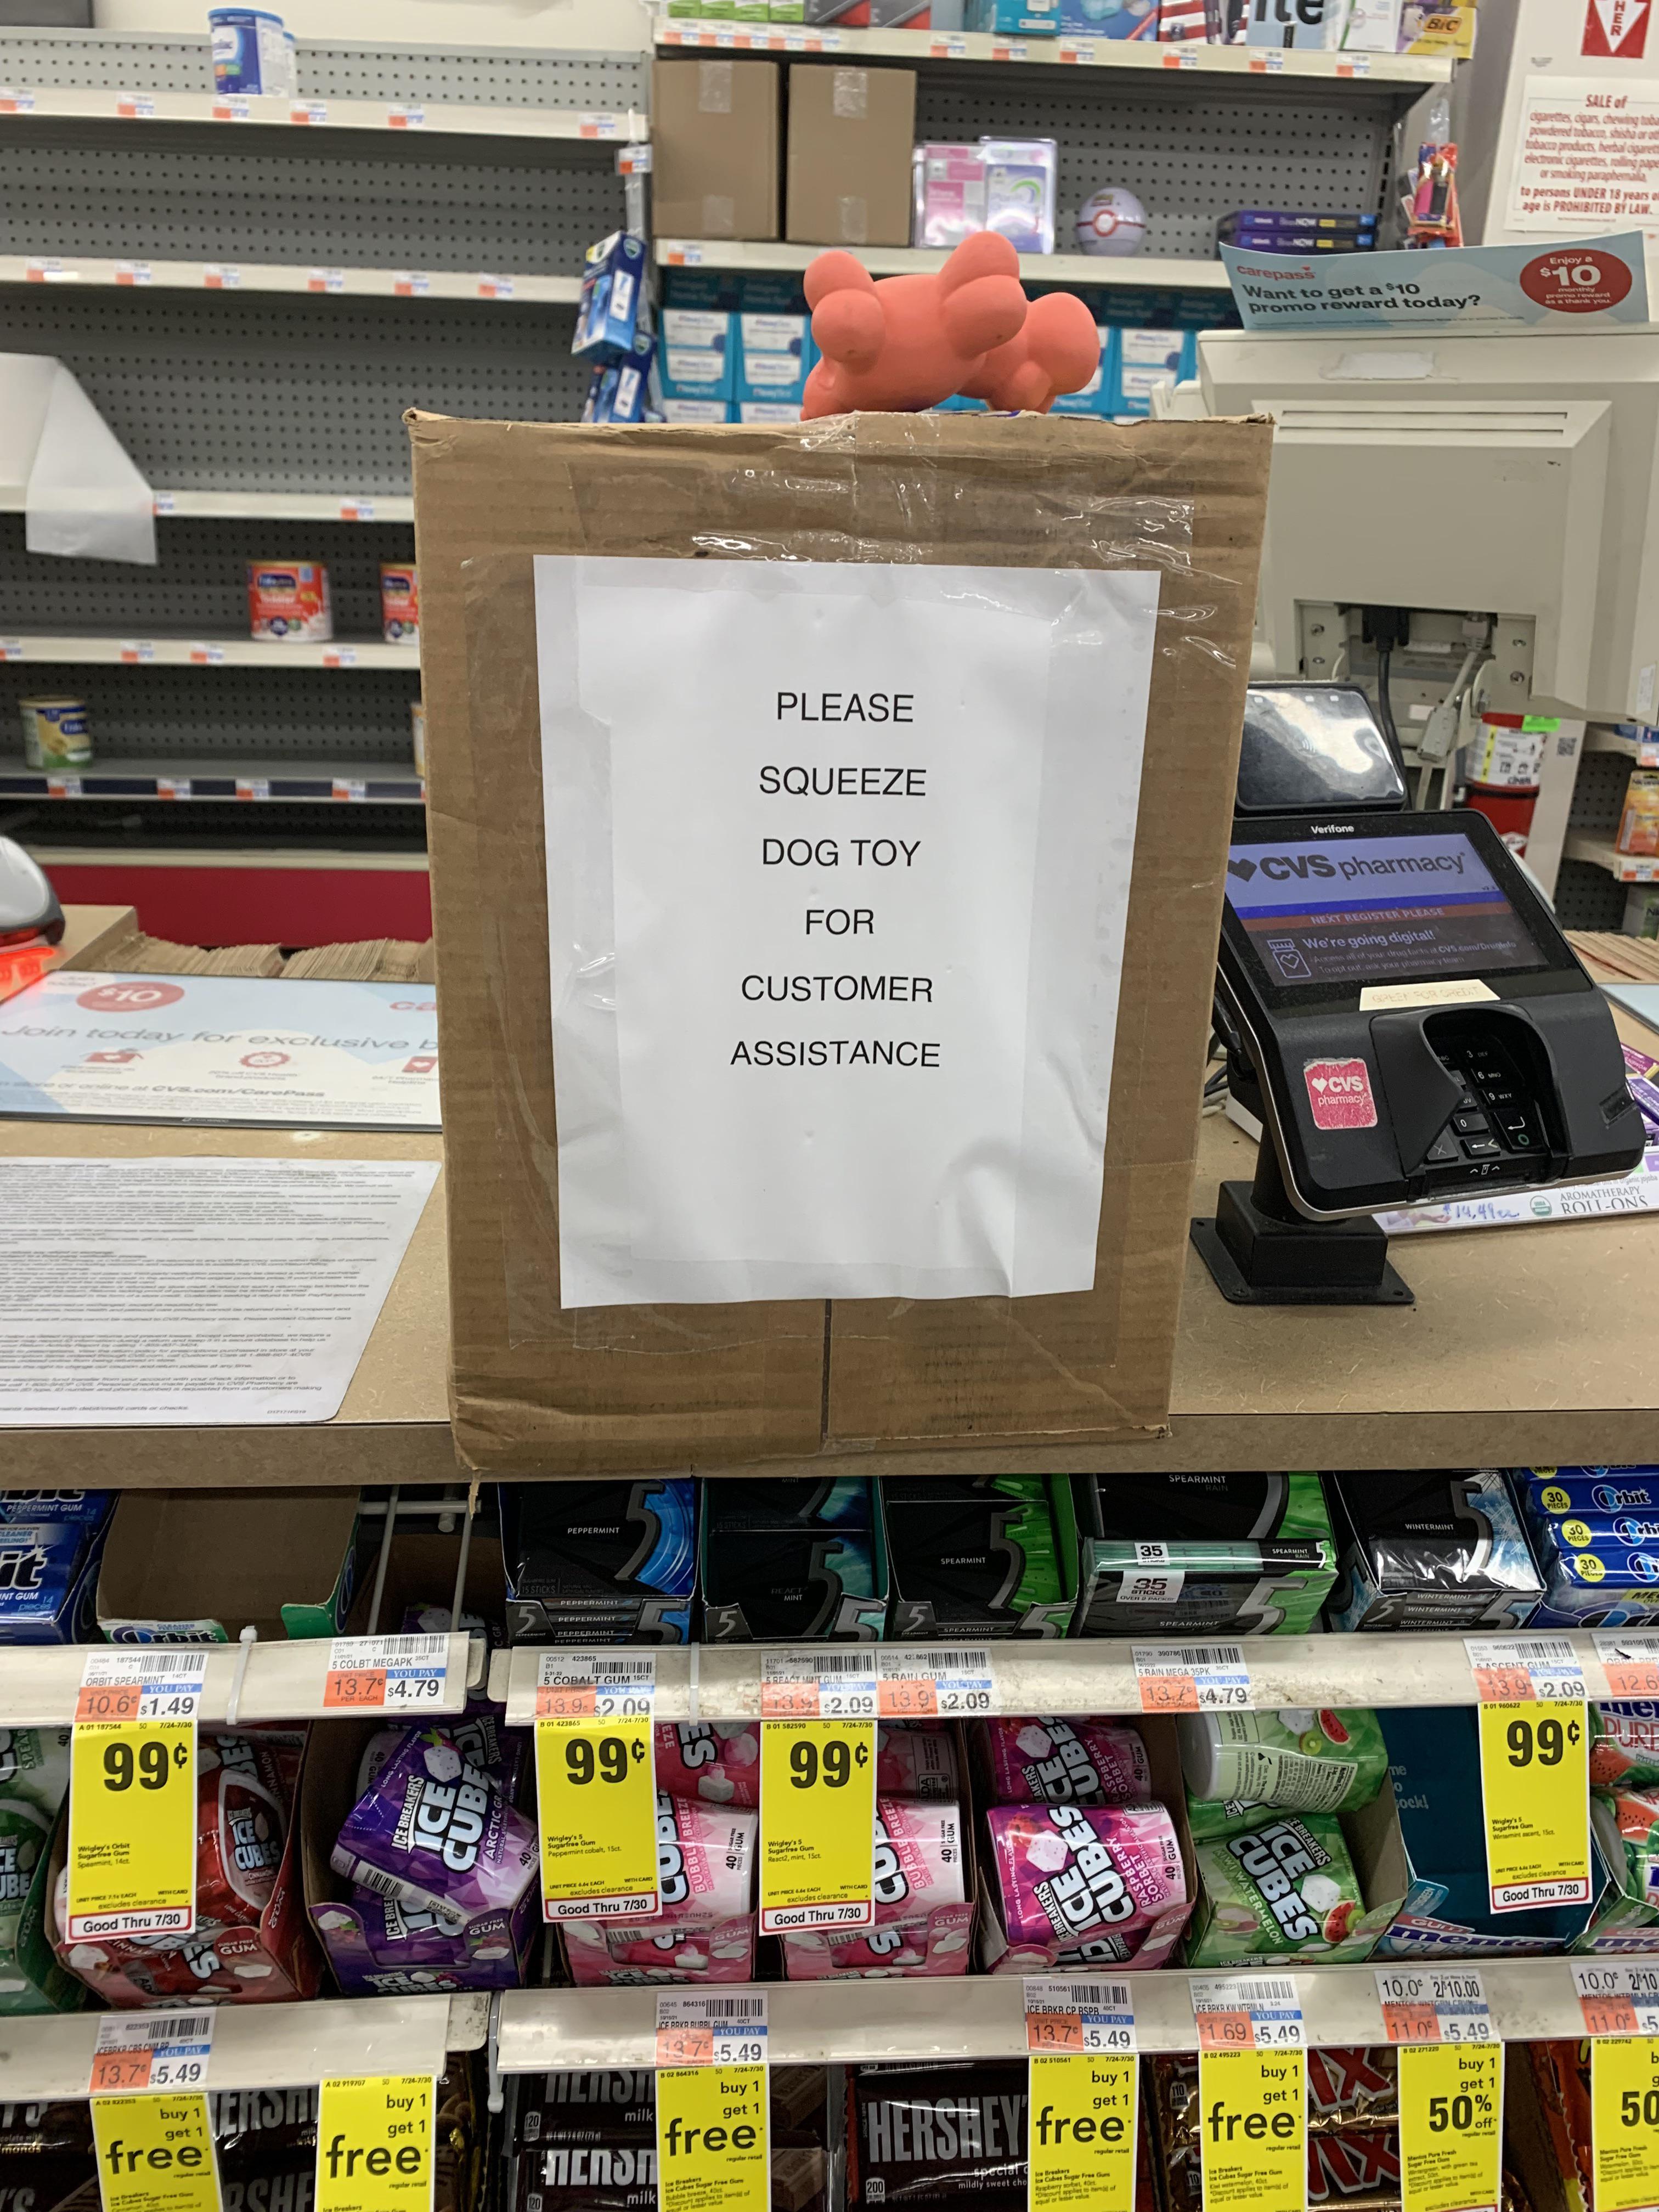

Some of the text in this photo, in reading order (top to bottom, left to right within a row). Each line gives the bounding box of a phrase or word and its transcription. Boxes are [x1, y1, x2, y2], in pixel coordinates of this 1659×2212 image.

[1586, 94, 1628, 109] SALE of
[1520, 185, 1649, 202] to persons UNDER 18 years
[1522, 202, 1541, 214] age
[1543, 200, 1550, 211] is
[1554, 201, 1612, 213] PROHIBITED
[1615, 202, 1627, 214] BY
[1550, 256, 1582, 265] Enjoy
[1237, 264, 1316, 281] carepass
[1539, 264, 1601, 286] $10
[1242, 283, 1420, 300] Want to get a $10
[1249, 295, 1481, 315] promo reward today?
[777, 692, 915, 723] PLEASE
[759, 765, 927, 796] SQUEEZE
[1311, 825, 1355, 834] Verifone
[763, 838, 922, 867] DOG TOY
[1260, 854, 1464, 881] CVS pharmacy
[806, 909, 874, 935] FOR
[1311, 907, 1445, 925] NEXT REGISTER PLEASE
[1301, 930, 1436, 950] We're going digital!
[98, 987, 163, 1003] $10
[741, 975, 933, 1003] CUSTOMER
[2, 1026, 409, 1050] Join today for exclusive
[730, 1041, 940, 1068] ASSISTANCE
[1466, 1050, 1474, 1058] 3
[1328, 1075, 1364, 1093] CVS
[1318, 1093, 1365, 1106] pharmacy
[1488, 1092, 1496, 1101] 9
[1559, 1186, 1640, 1201] AROMATHERAPY
[1169, 1474, 1226, 1485] SPEARMINT
[1547, 1491, 1563, 1502] 30
[1592, 1485, 1651, 1514] Orbit
[7, 1504, 58, 1513] PEPPERMINT
[567, 1526, 620, 1535] PEPPERMINT
[614, 1482, 664, 1581] 5
[1140, 1545, 1164, 1558] 35
[940, 1557, 986, 1565] SPEARMINT
[1135, 1577, 1170, 1592] 35
[112, 1626, 219, 1644] Orbit
[332, 1661, 337, 1669] 5
[340, 1659, 370, 1669] COLBT
[373, 1657, 413, 1668] MEGAPK
[86, 1676, 165, 1687] ORBIT SPEARMINT
[393, 1669, 437, 1678] YOU PAY
[553, 1676, 601, 1685] COBALT
[604, 1675, 630, 1684] GUM
[387, 1679, 439, 1699] $4.79
[1199, 1688, 1248, 1705] $4.79
[1539, 1681, 1585, 1698] $2.09
[140, 1697, 194, 1716] $1.49
[1506, 1719, 1581, 1768] 99¢
[103, 1740, 188, 1792] 99¢
[565, 1737, 645, 1785] 99¢
[790, 1740, 868, 1789] 99¢
[413, 1781, 456, 1852] ICE
[233, 1820, 256, 1843] ICE
[548, 1835, 577, 1844] Wrigley's
[548, 1841, 578, 1850] Sugarfree
[548, 1849, 583, 1859] Peppermint
[584, 1847, 606, 1855] cobalt,
[1050, 1805, 1138, 1924] CUBES
[1106, 1836, 1152, 1908] RASPBERRY
[1131, 1853, 1165, 1904] SORBET
[1226, 1835, 1323, 1941] CUBES
[1503, 1884, 1579, 1903] Good Thru 7/30
[557, 1899, 648, 1916] Good Thru 7/30
[1235, 1870, 1283, 1946] WATERMELON
[83, 1913, 180, 1933] Good Thru 7/30
[469, 1922, 505, 1937] GUM
[1382, 1978, 1424, 1997] 10.0¢
[1027, 2005, 1099, 2016] ICE BRKR CP RSPB
[1087, 2016, 1127, 2024] YOU PAY
[1084, 2030, 1131, 2049] $5.49
[149, 2064, 201, 2084] $5.49
[1091, 2071, 1130, 2084] buy 1
[1092, 2095, 1129, 2109] get 1
[624, 2108, 653, 2122] milk
[1035, 2106, 1124, 2146] free
[664, 2117, 757, 2157] free
[867, 2181, 884, 2193] 200
[958, 2180, 984, 2191] mildly
